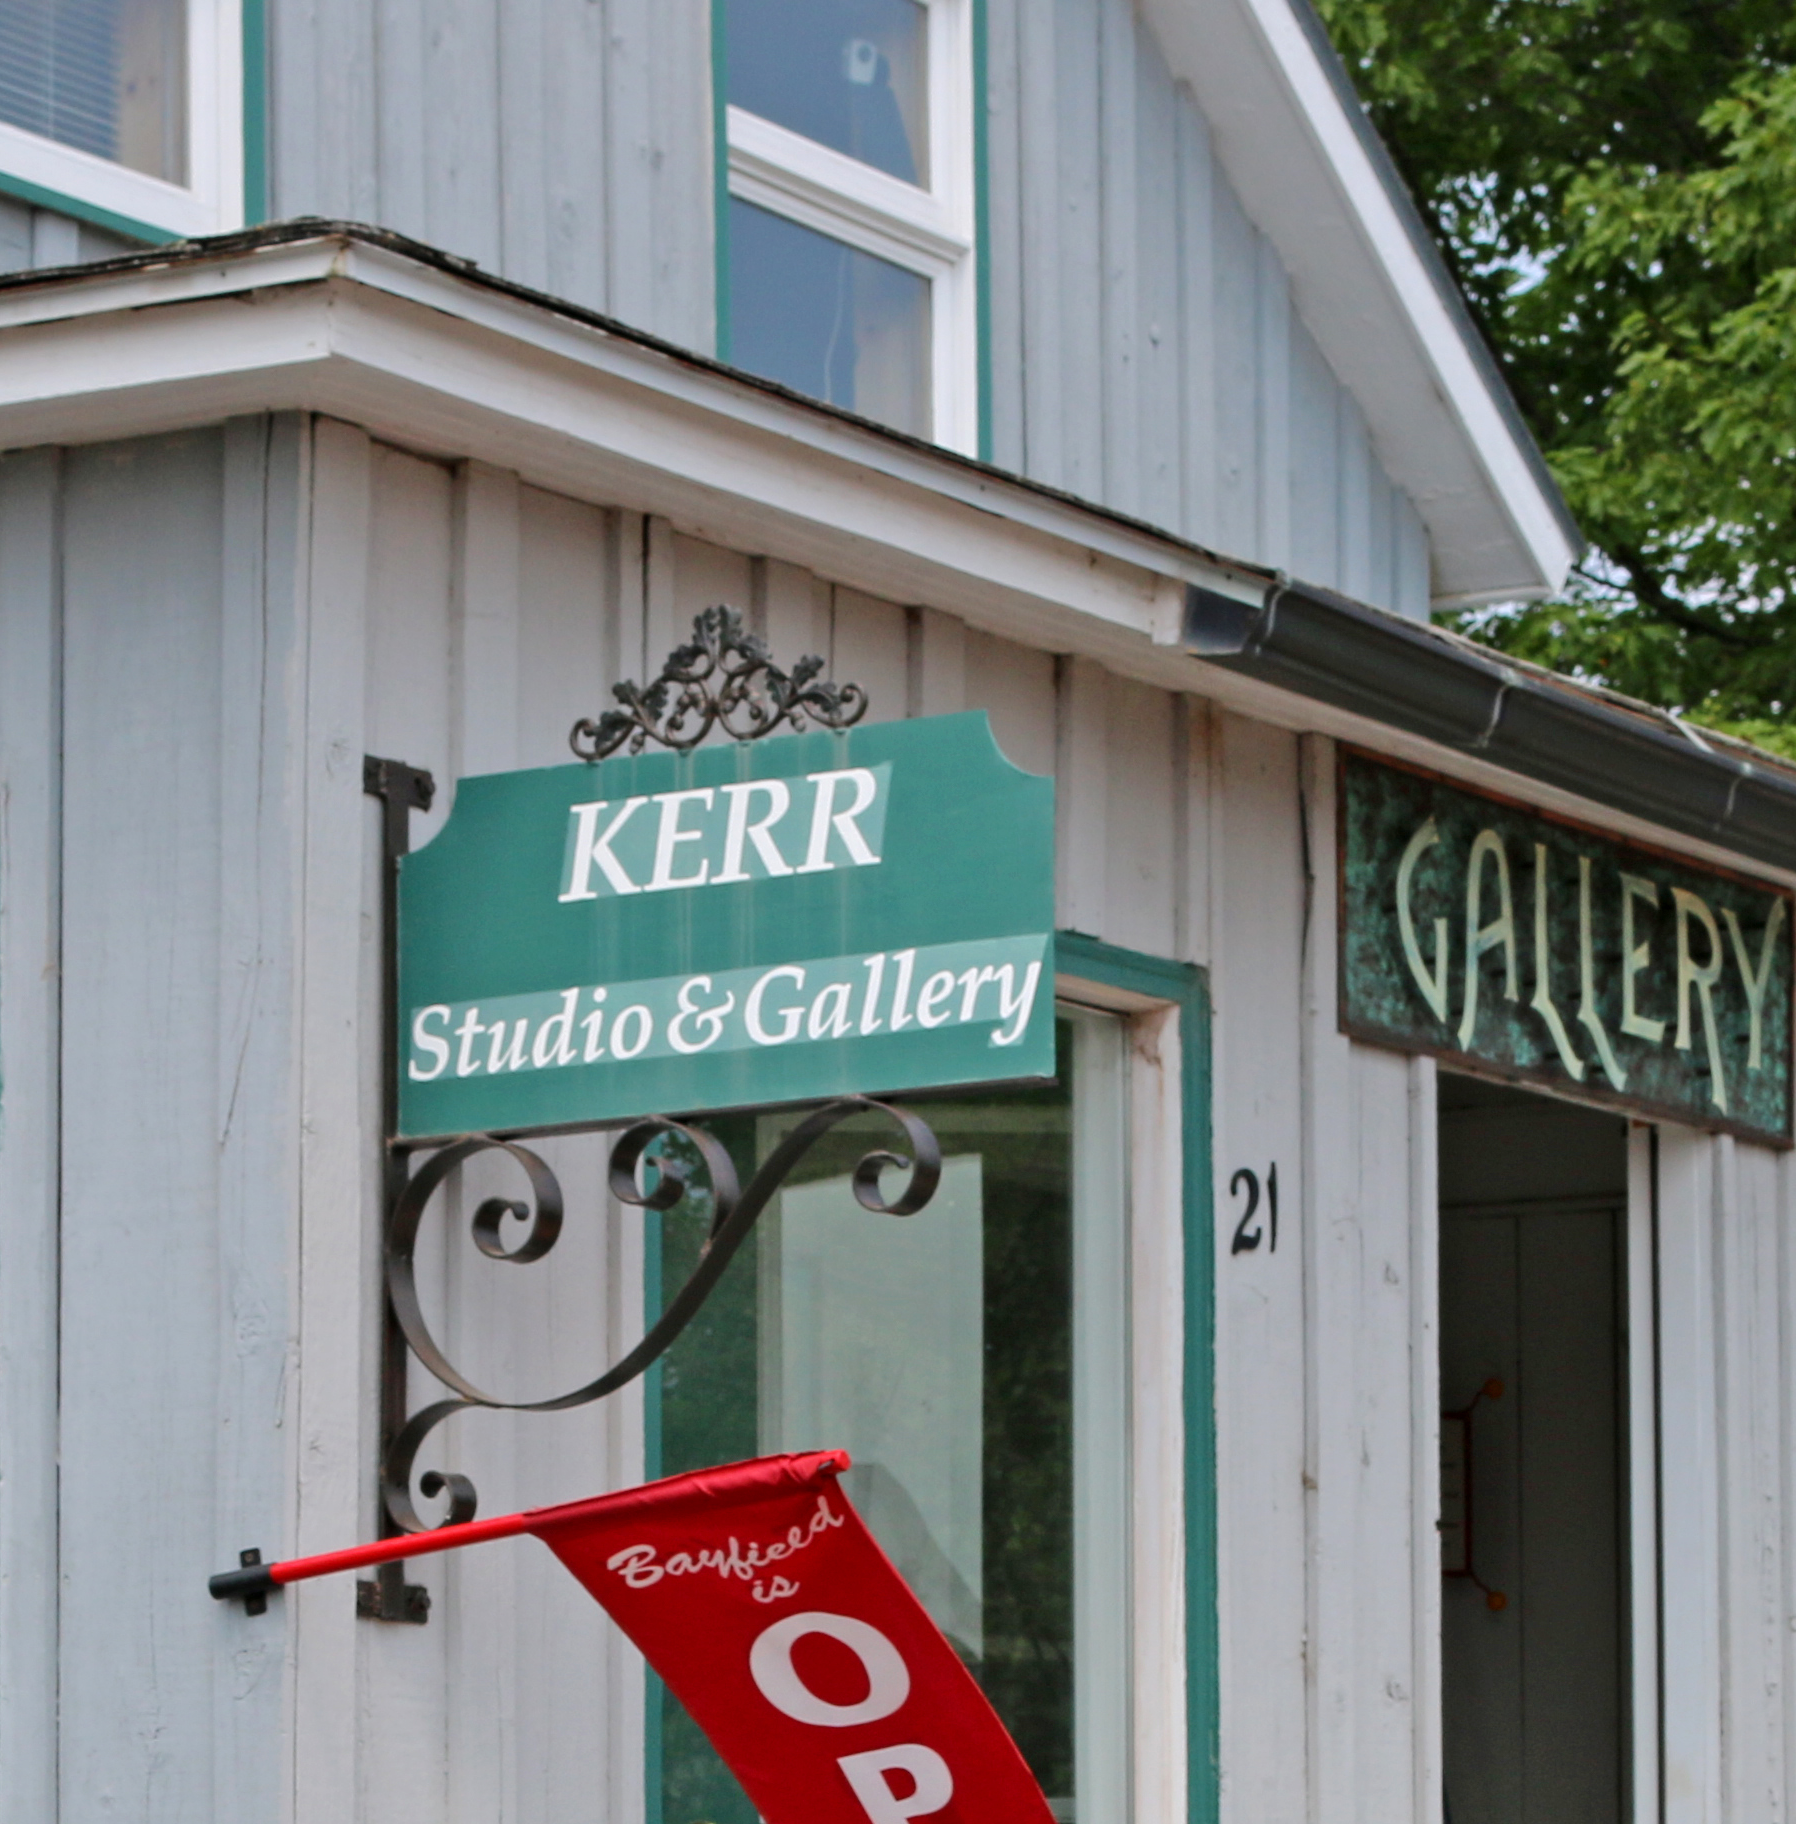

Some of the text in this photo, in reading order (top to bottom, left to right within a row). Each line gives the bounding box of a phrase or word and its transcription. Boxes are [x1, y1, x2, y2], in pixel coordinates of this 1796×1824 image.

[558, 766, 883, 904] KERR
[407, 950, 1041, 1083] Studio & Gallery
[1395, 814, 1788, 1116] GALLERY
[1229, 1160, 1278, 1256] 21
[607, 1496, 844, 1589] Bayfield
[752, 1573, 800, 1603] is
